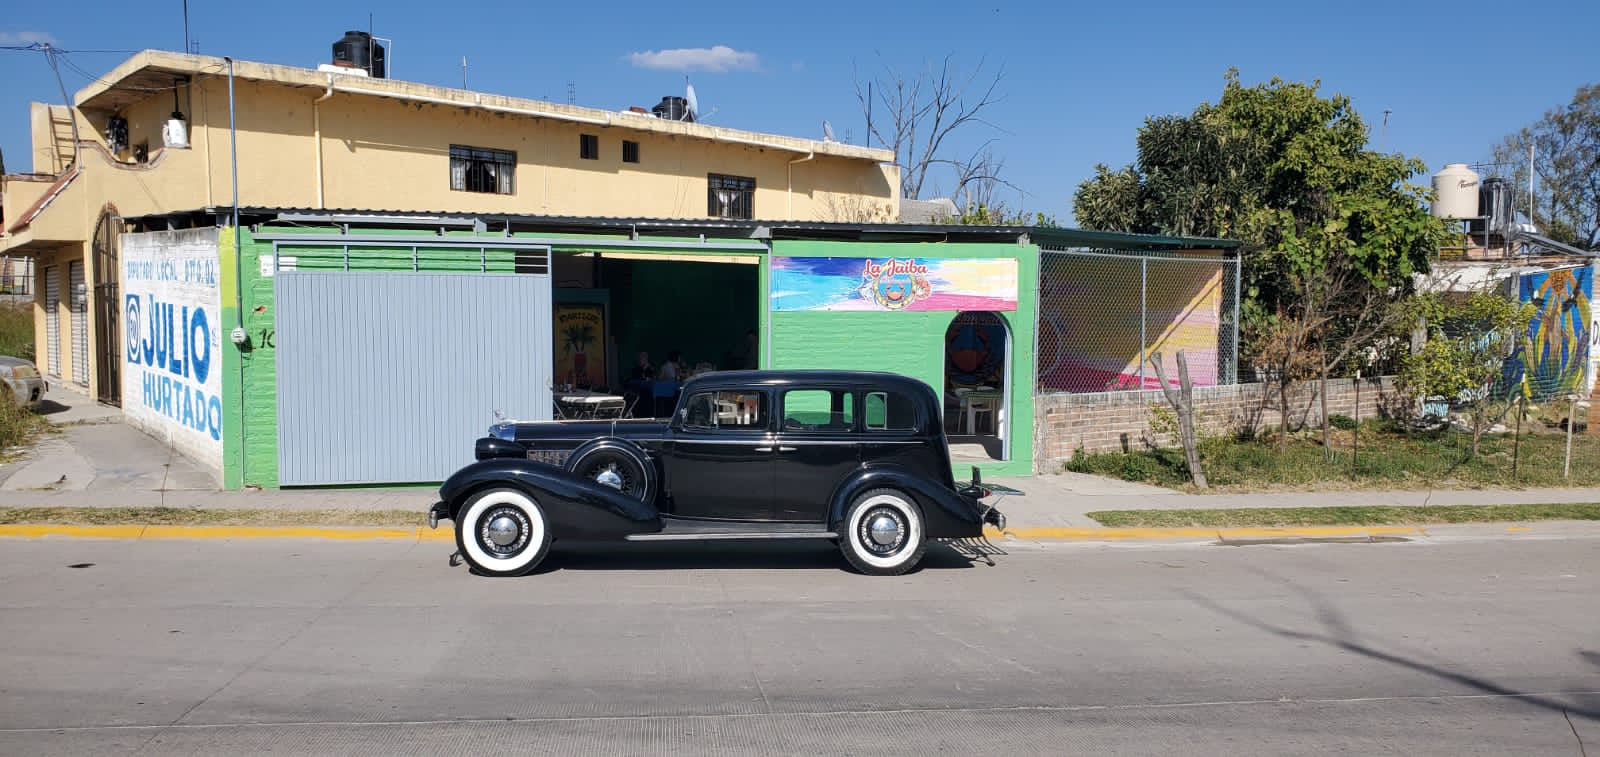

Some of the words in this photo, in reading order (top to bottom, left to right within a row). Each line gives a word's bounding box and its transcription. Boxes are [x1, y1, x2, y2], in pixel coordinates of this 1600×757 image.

[156, 260, 178, 281] LOCAL
[864, 259, 880, 278] La
[887, 258, 928, 277] Jaiba
[142, 294, 211, 384] JULIO
[143, 371, 222, 441] HURTADO
